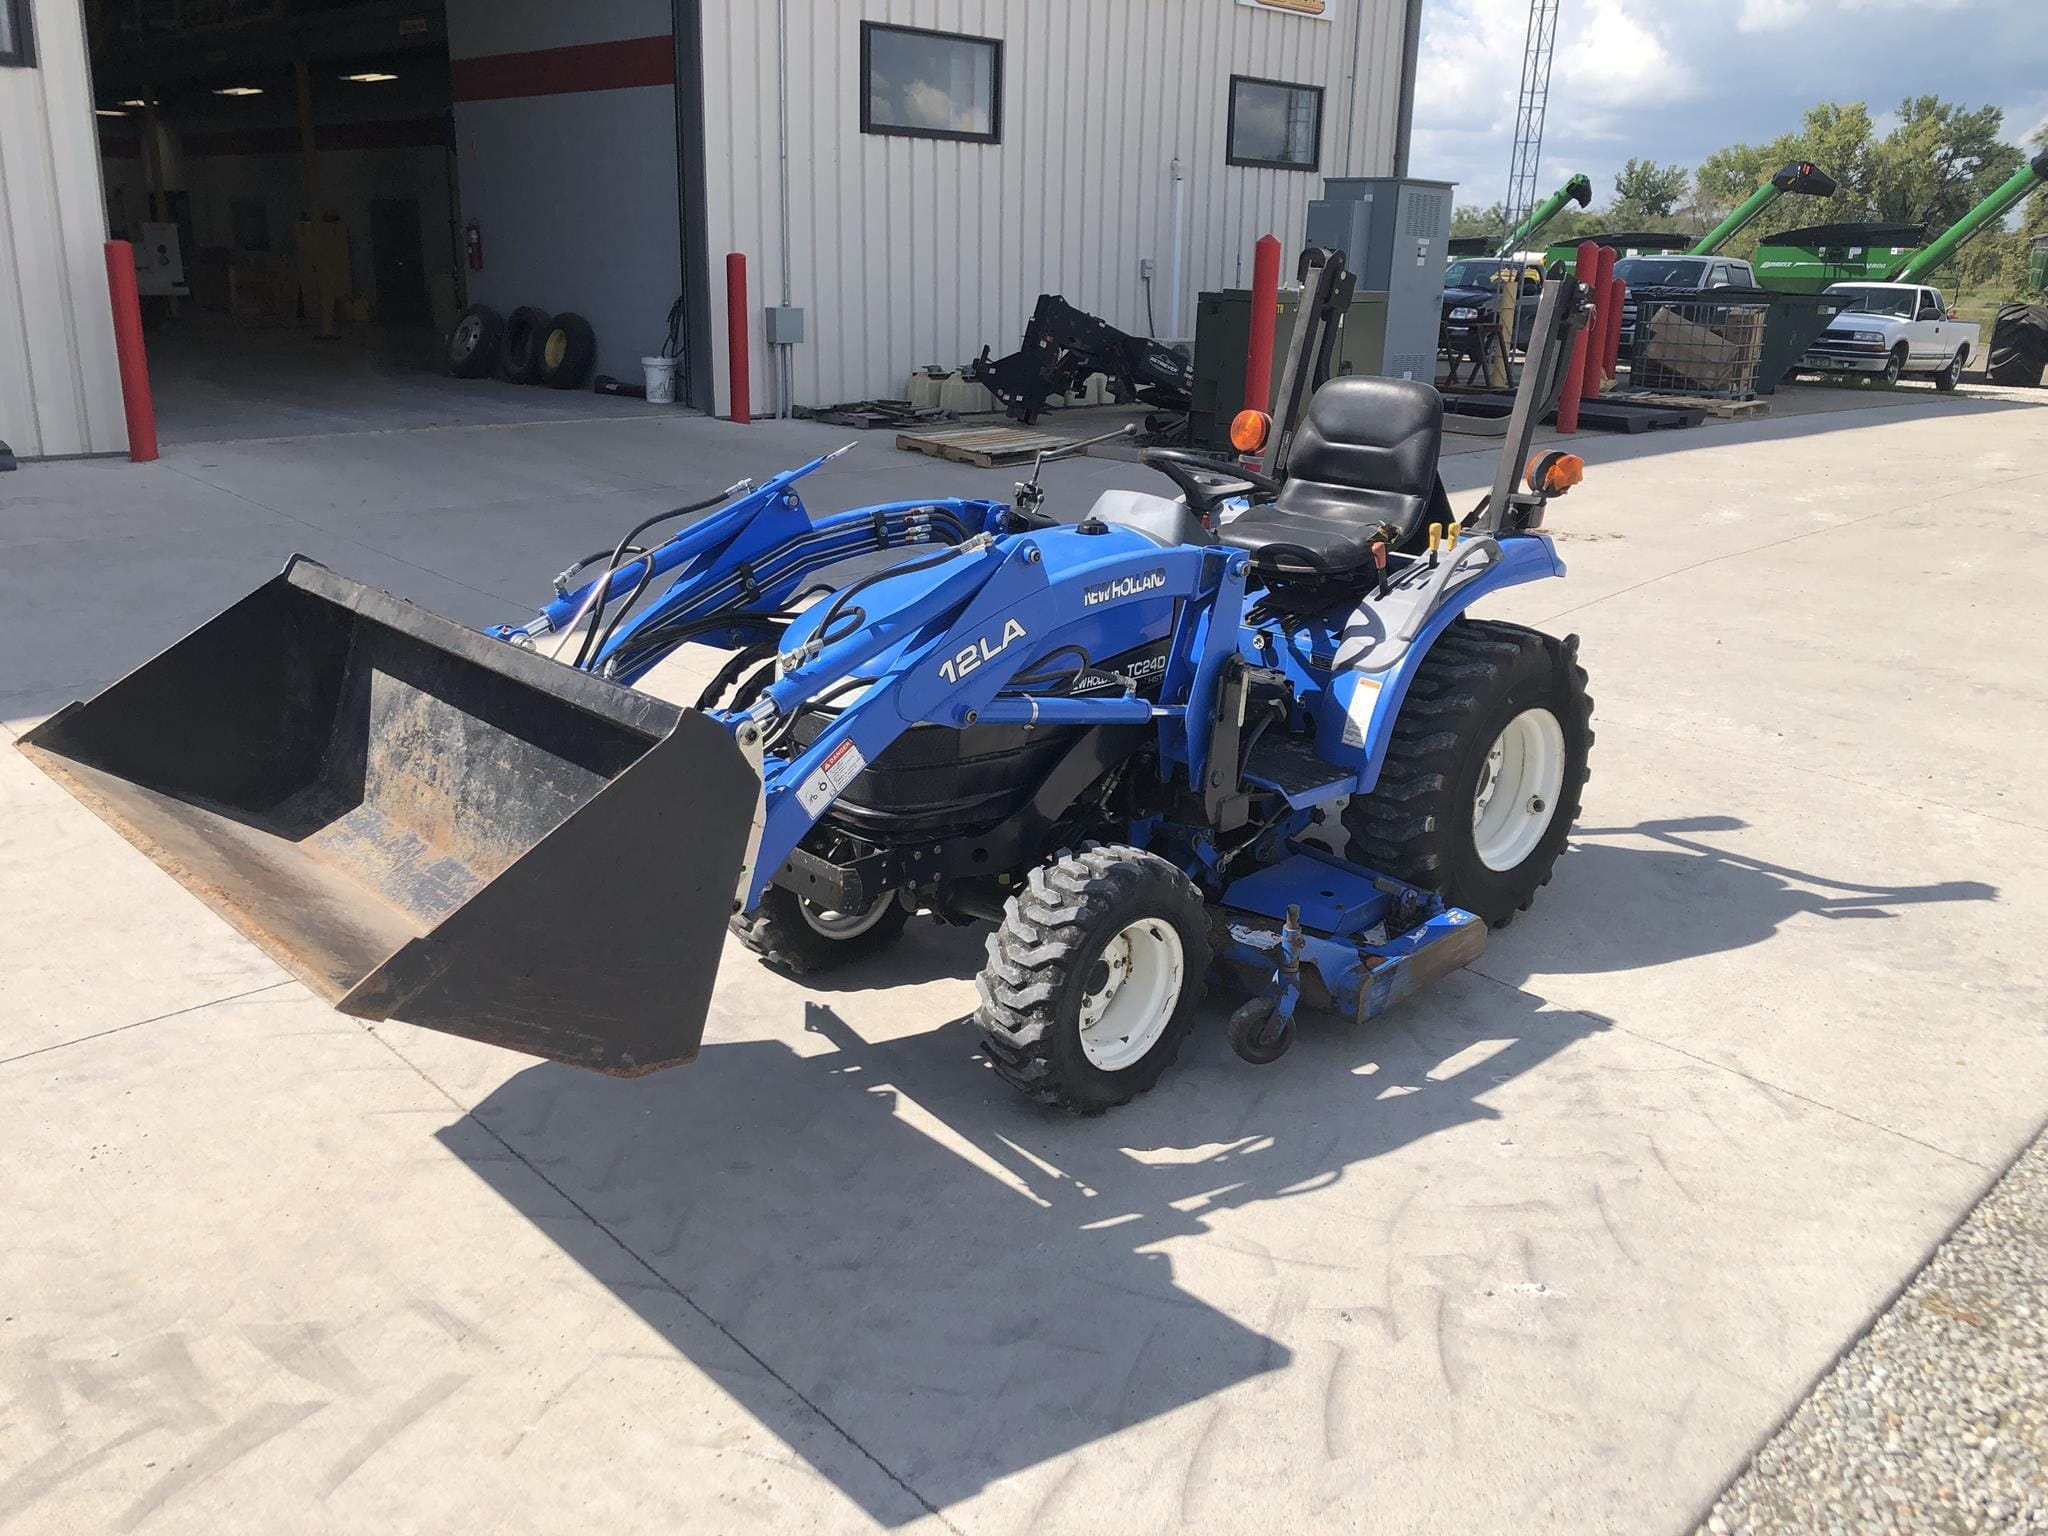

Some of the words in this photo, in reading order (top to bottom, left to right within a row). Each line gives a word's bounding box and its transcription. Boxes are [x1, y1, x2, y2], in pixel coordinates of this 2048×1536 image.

[1083, 582, 1111, 606] NEW
[1111, 567, 1166, 599] HOLLAND
[938, 617, 1028, 684] 12LA
[1127, 655, 1166, 677] TC24D
[829, 741, 851, 764] DANGER
